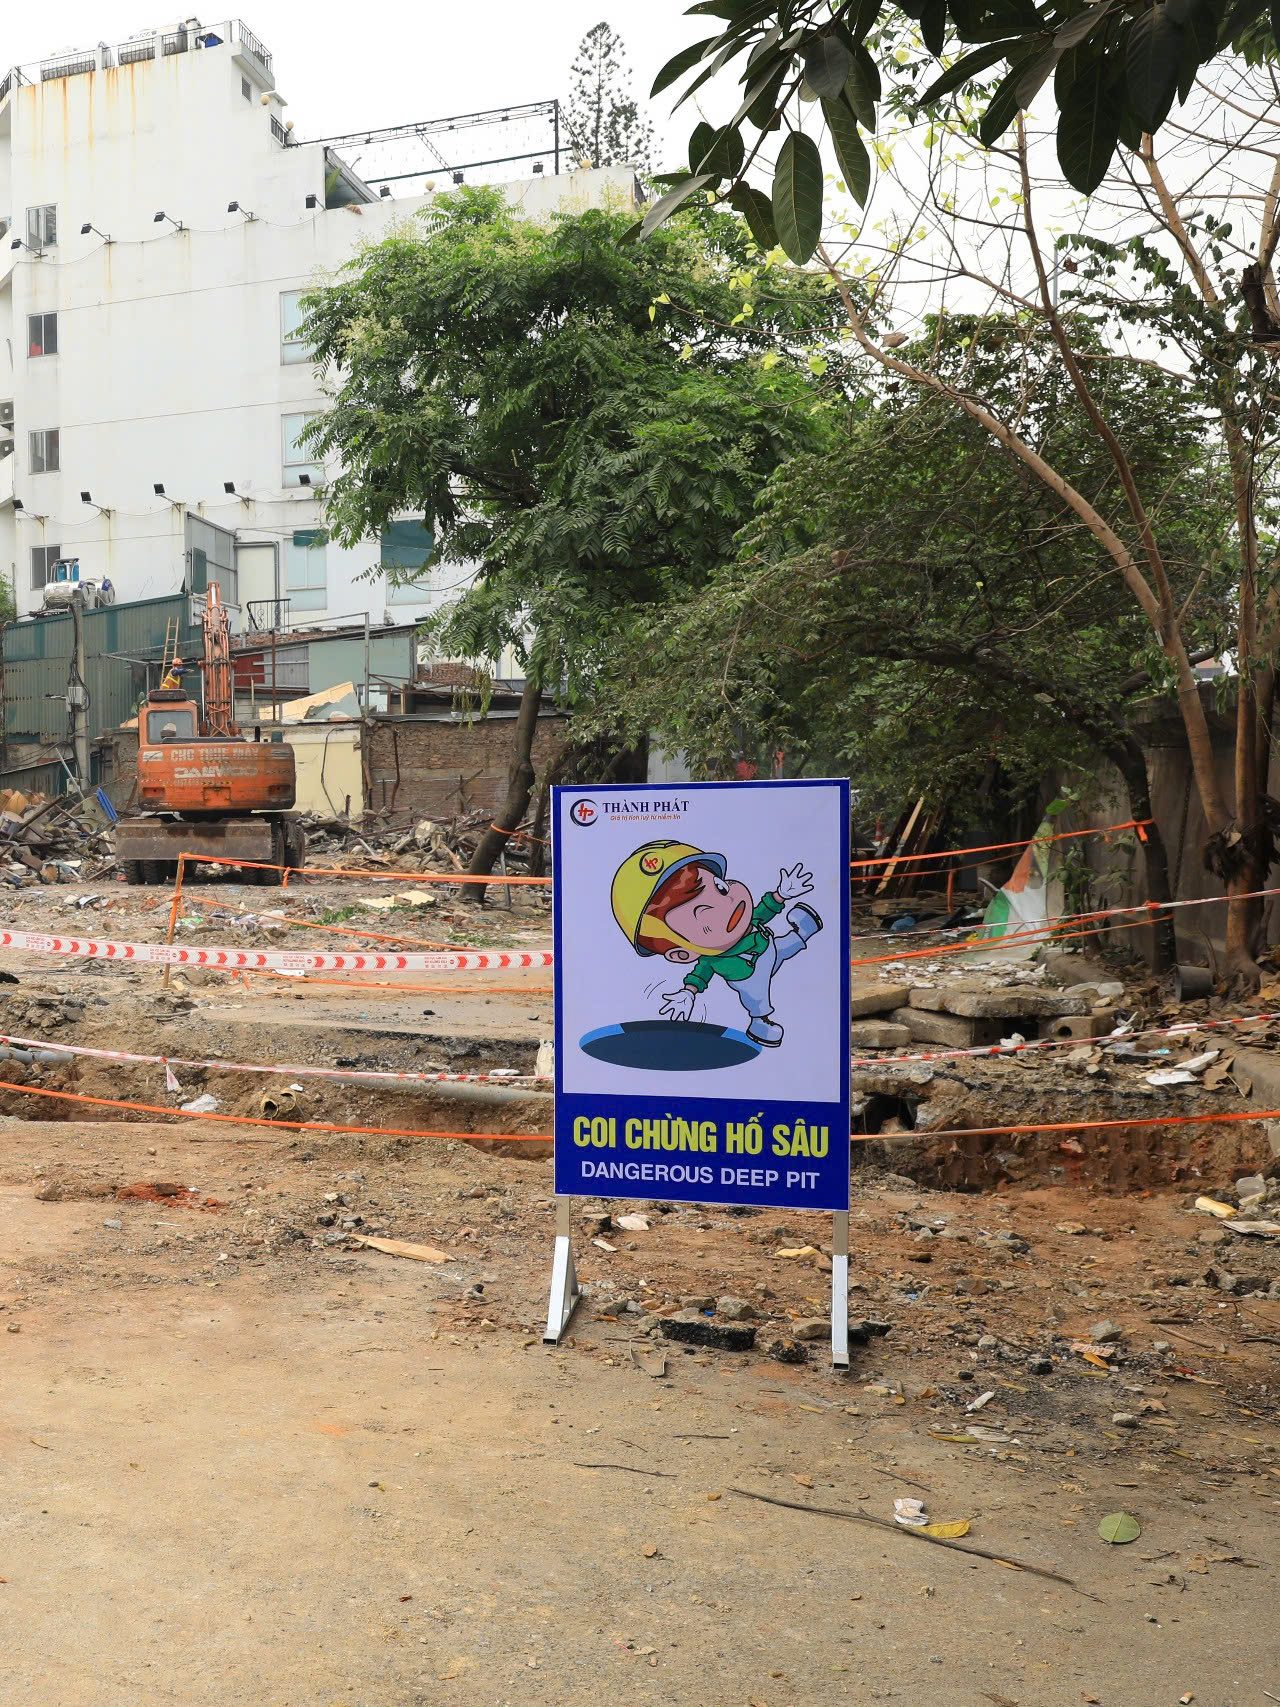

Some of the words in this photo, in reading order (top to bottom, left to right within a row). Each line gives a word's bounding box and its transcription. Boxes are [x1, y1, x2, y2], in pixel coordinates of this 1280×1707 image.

[171, 749, 195, 761] CHO
[174, 766, 258, 778] DAEWOO
[602, 799, 649, 813] THÀNH
[653, 798, 690, 812] PHÁT
[573, 1116, 617, 1148] COI
[625, 1112, 718, 1153] CHỪNG
[726, 1112, 764, 1155] HỐ
[771, 1118, 829, 1158] SÂU
[581, 1160, 714, 1184] DANGEROUS
[720, 1168, 779, 1187] DEEP
[786, 1171, 821, 1190] PIT
